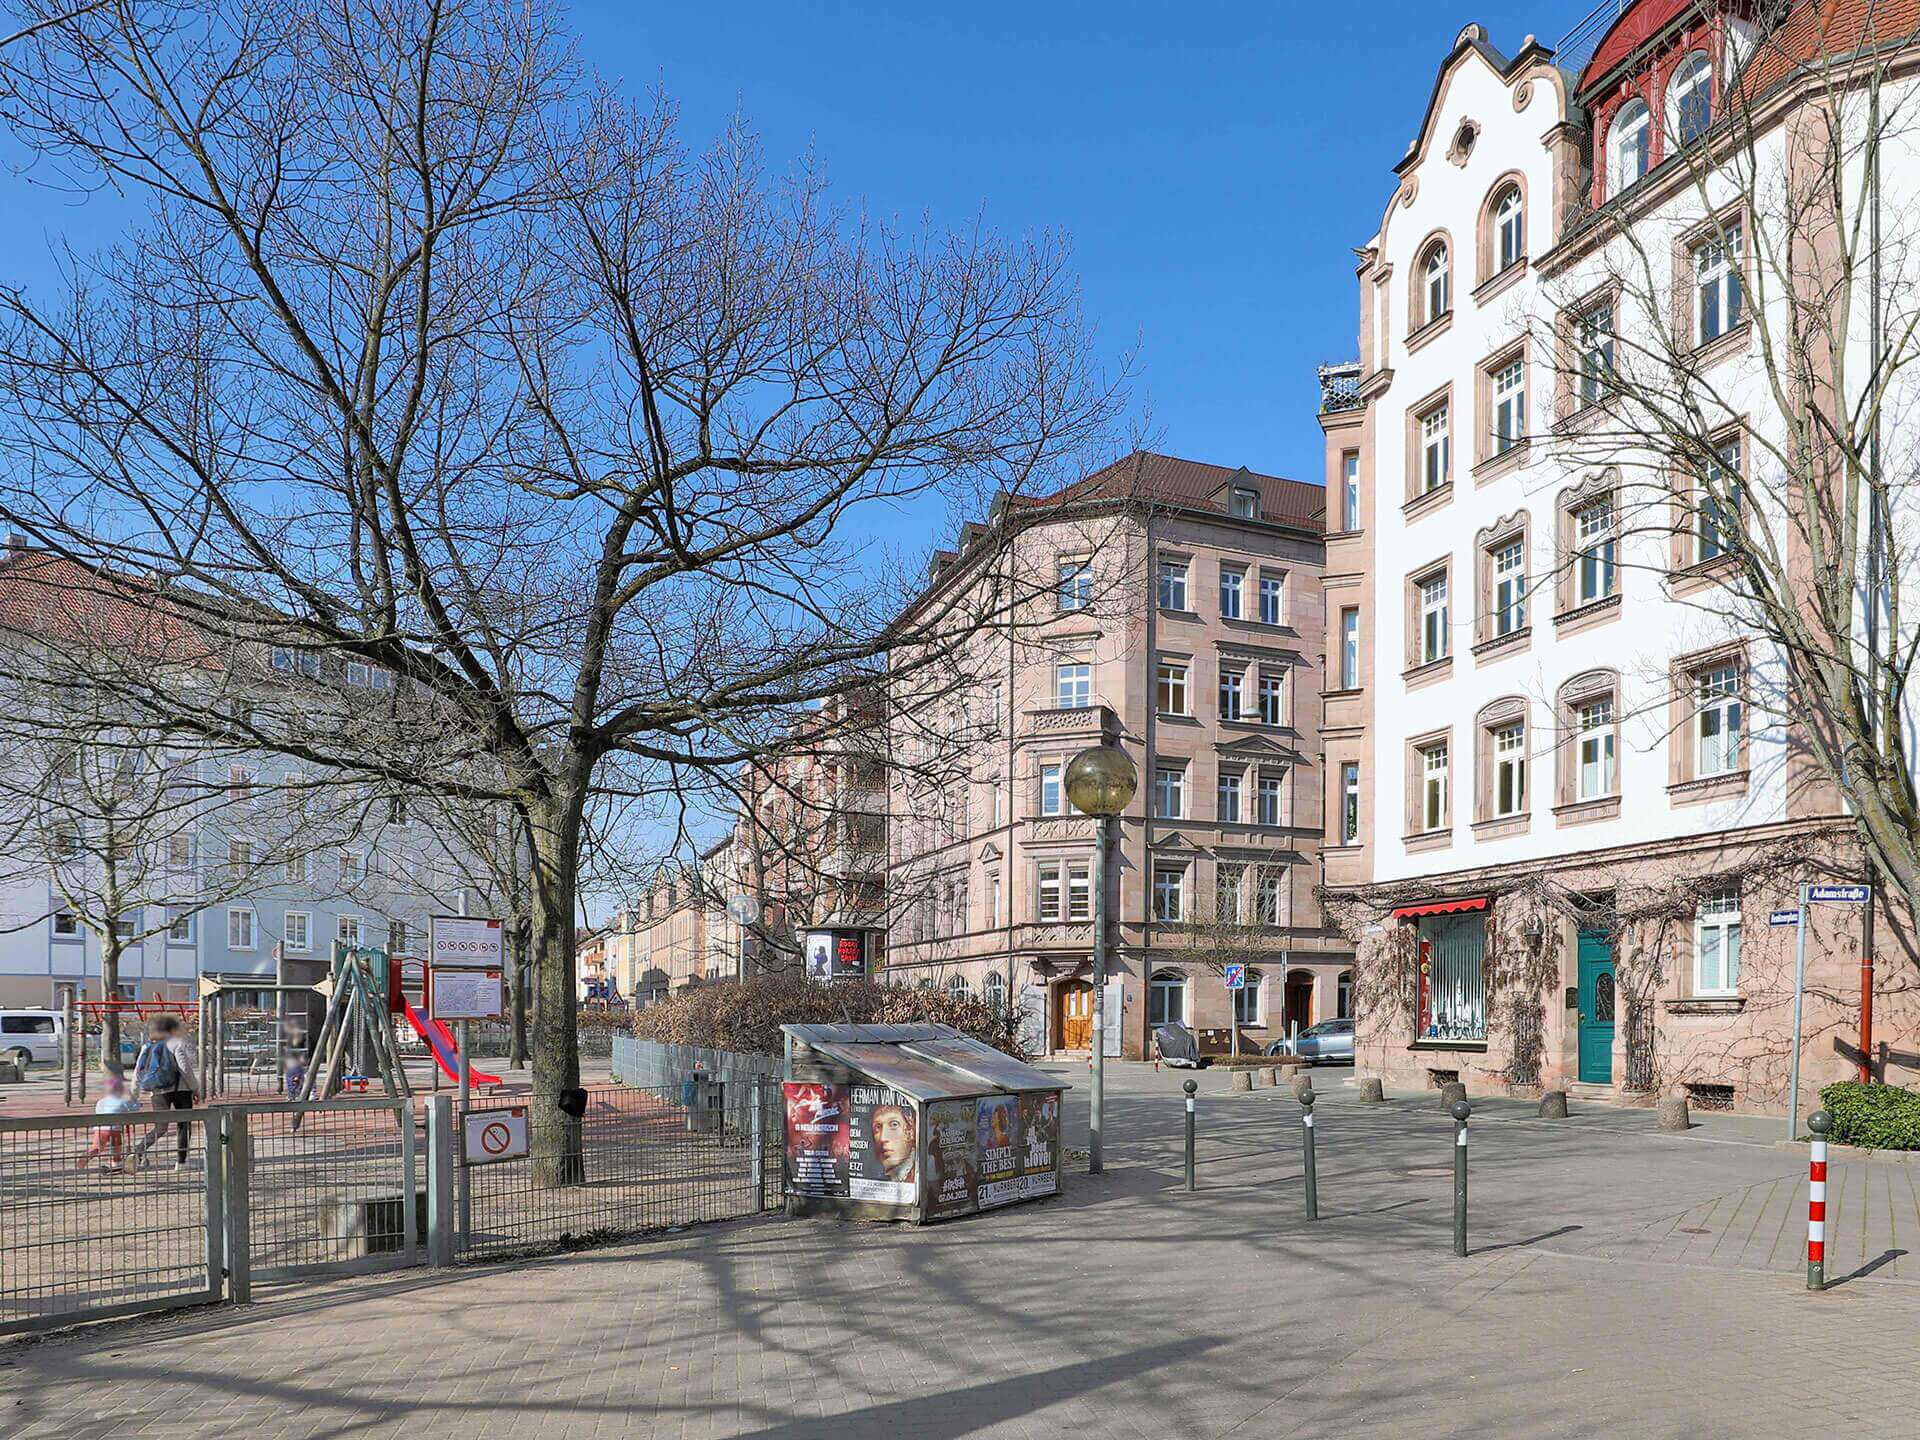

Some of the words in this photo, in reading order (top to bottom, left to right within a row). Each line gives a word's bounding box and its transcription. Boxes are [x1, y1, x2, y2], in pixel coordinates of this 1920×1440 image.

[1812, 887, 1864, 899] Adamstraße
[851, 1087, 879, 1105] HERMAN
[880, 1088, 895, 1106] VAN
[985, 1146, 1011, 1160] SIMPLY
[981, 1160, 998, 1174] THE
[1000, 1156, 1016, 1171] BEST
[979, 1186, 991, 1200] 21.
